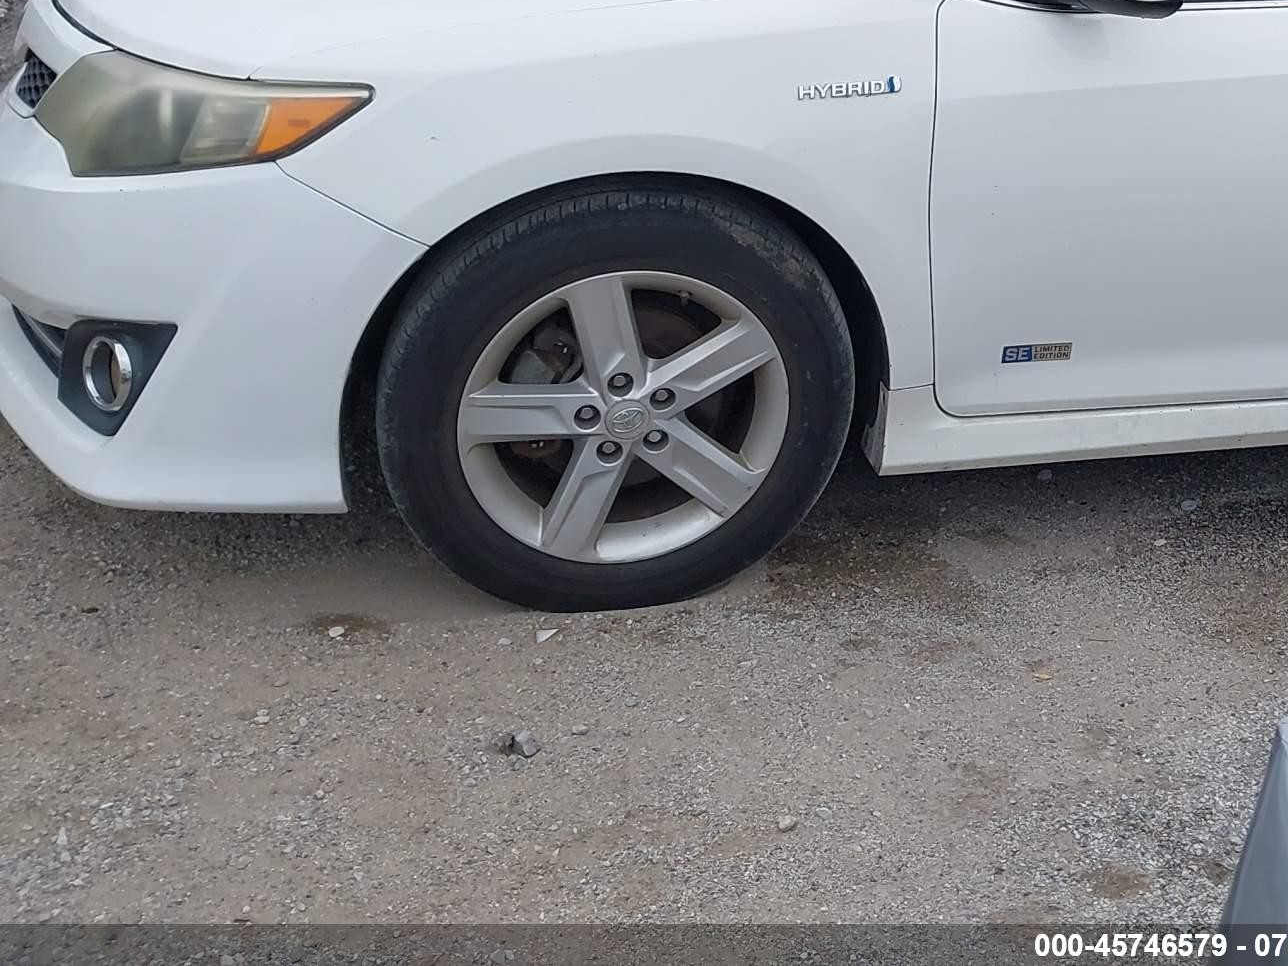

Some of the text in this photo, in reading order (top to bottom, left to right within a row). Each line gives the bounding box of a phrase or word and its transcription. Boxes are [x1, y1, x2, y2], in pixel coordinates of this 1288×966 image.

[797, 80, 886, 100] HYBRID
[1004, 347, 1031, 362] SE
[1034, 345, 1070, 353] LIMITED
[1033, 351, 1070, 360] EDITION
